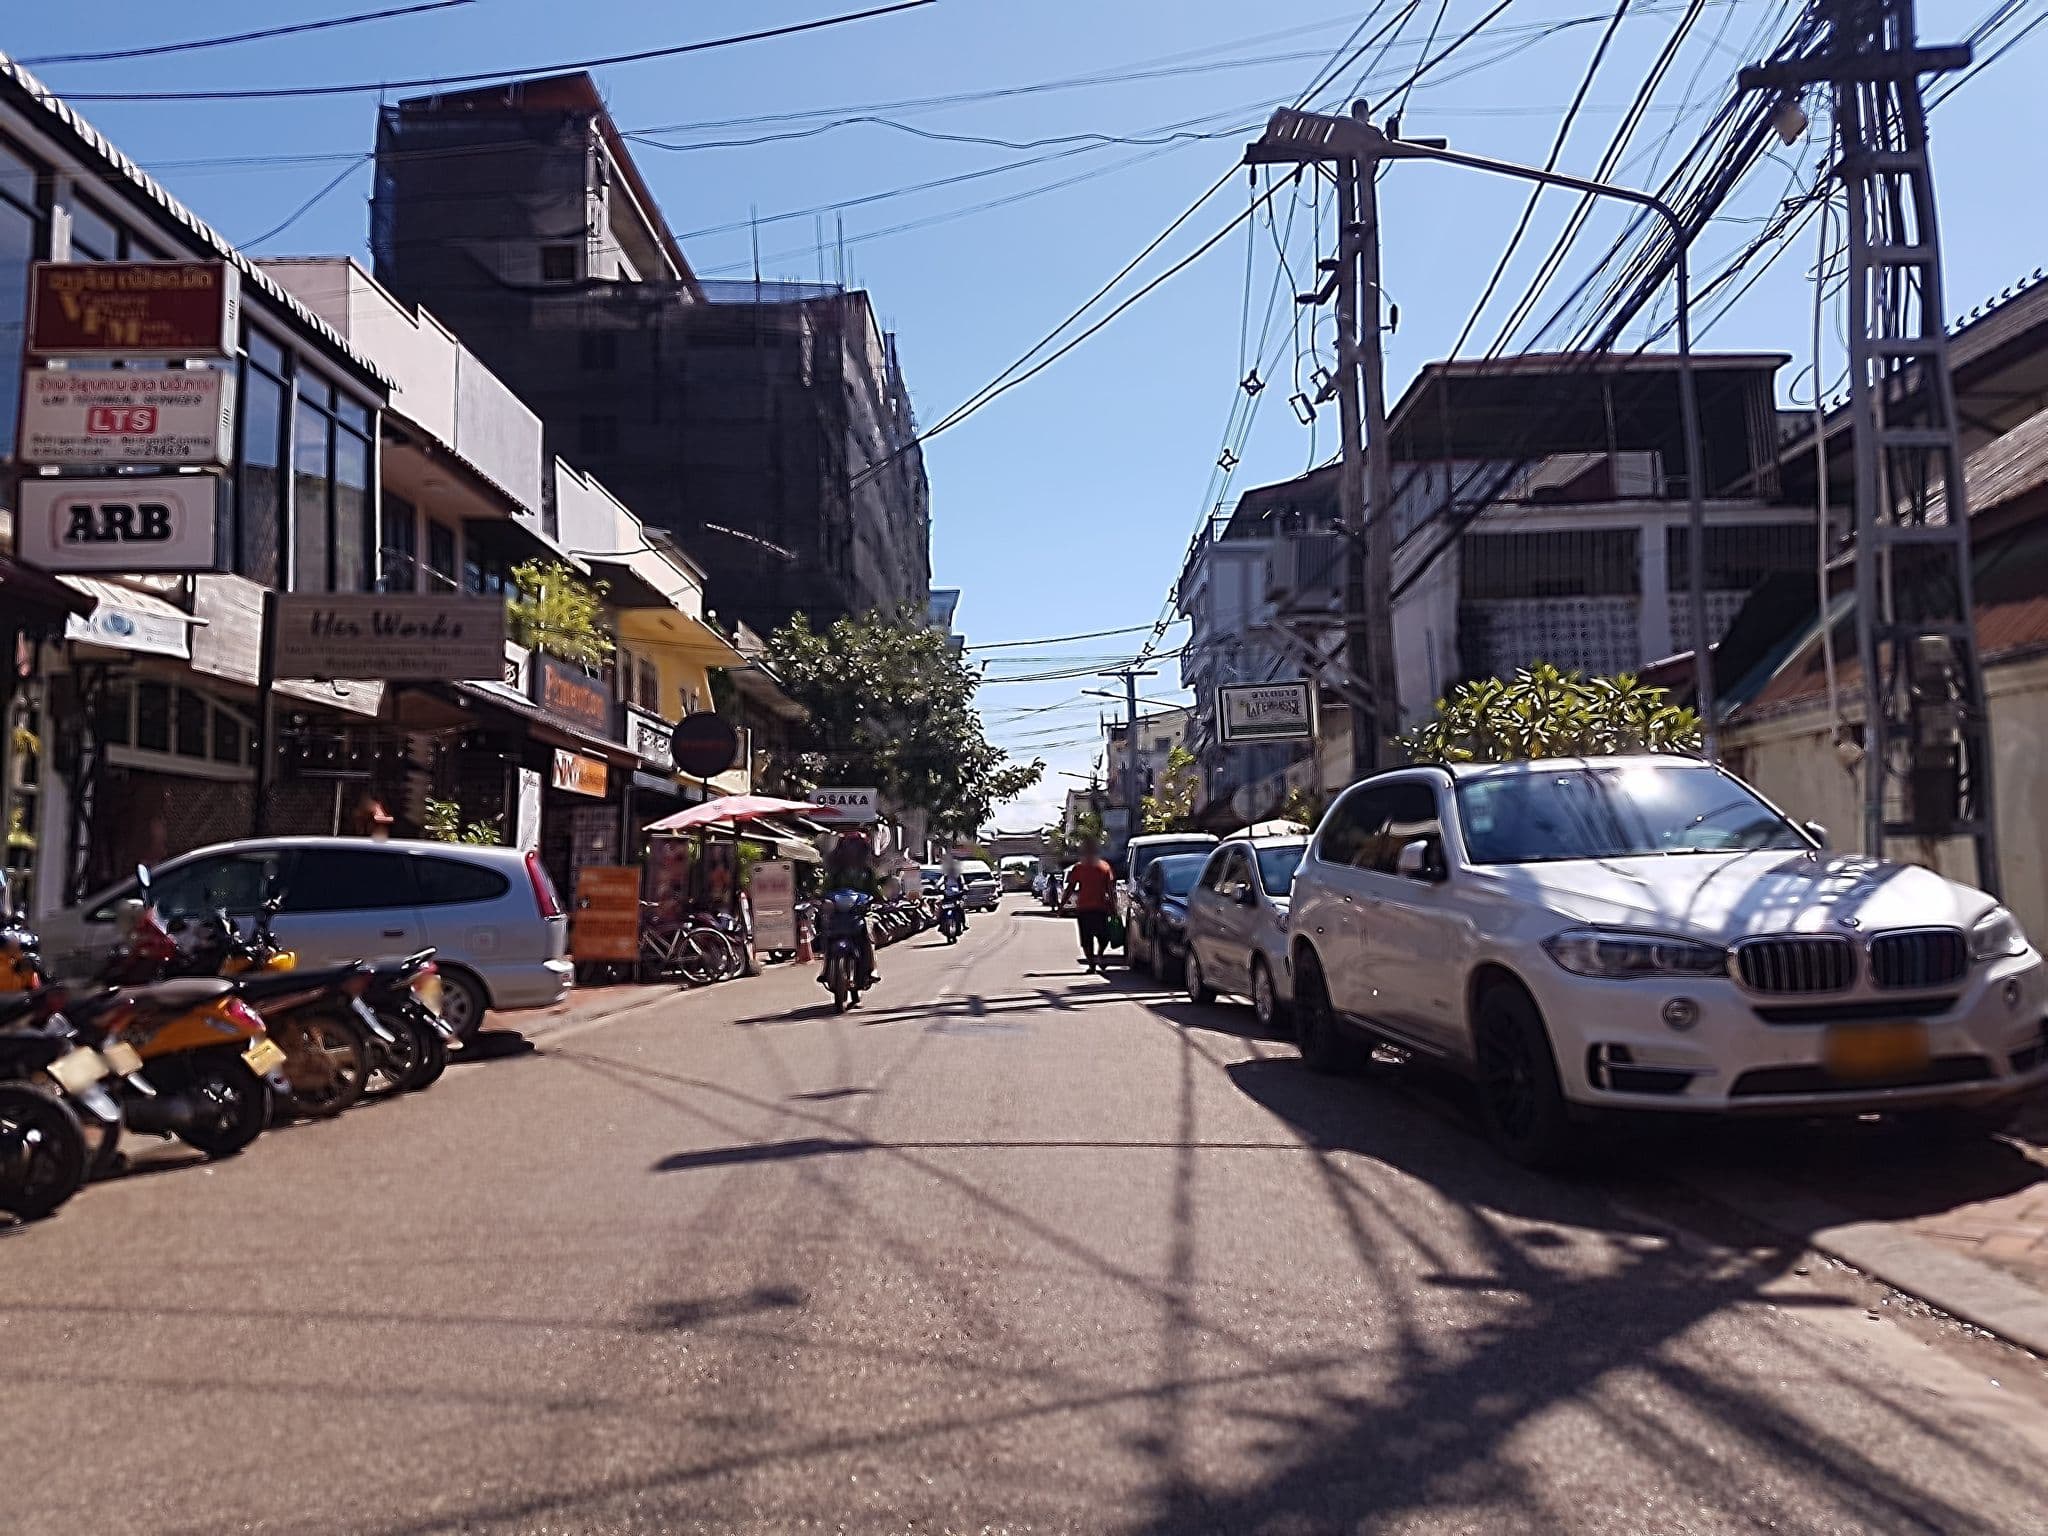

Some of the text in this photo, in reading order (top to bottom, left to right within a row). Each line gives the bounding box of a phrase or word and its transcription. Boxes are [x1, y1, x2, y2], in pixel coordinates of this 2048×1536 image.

[92, 409, 152, 431] LTS
[65, 504, 171, 543] ARB
[816, 794, 869, 806] OSAKA
